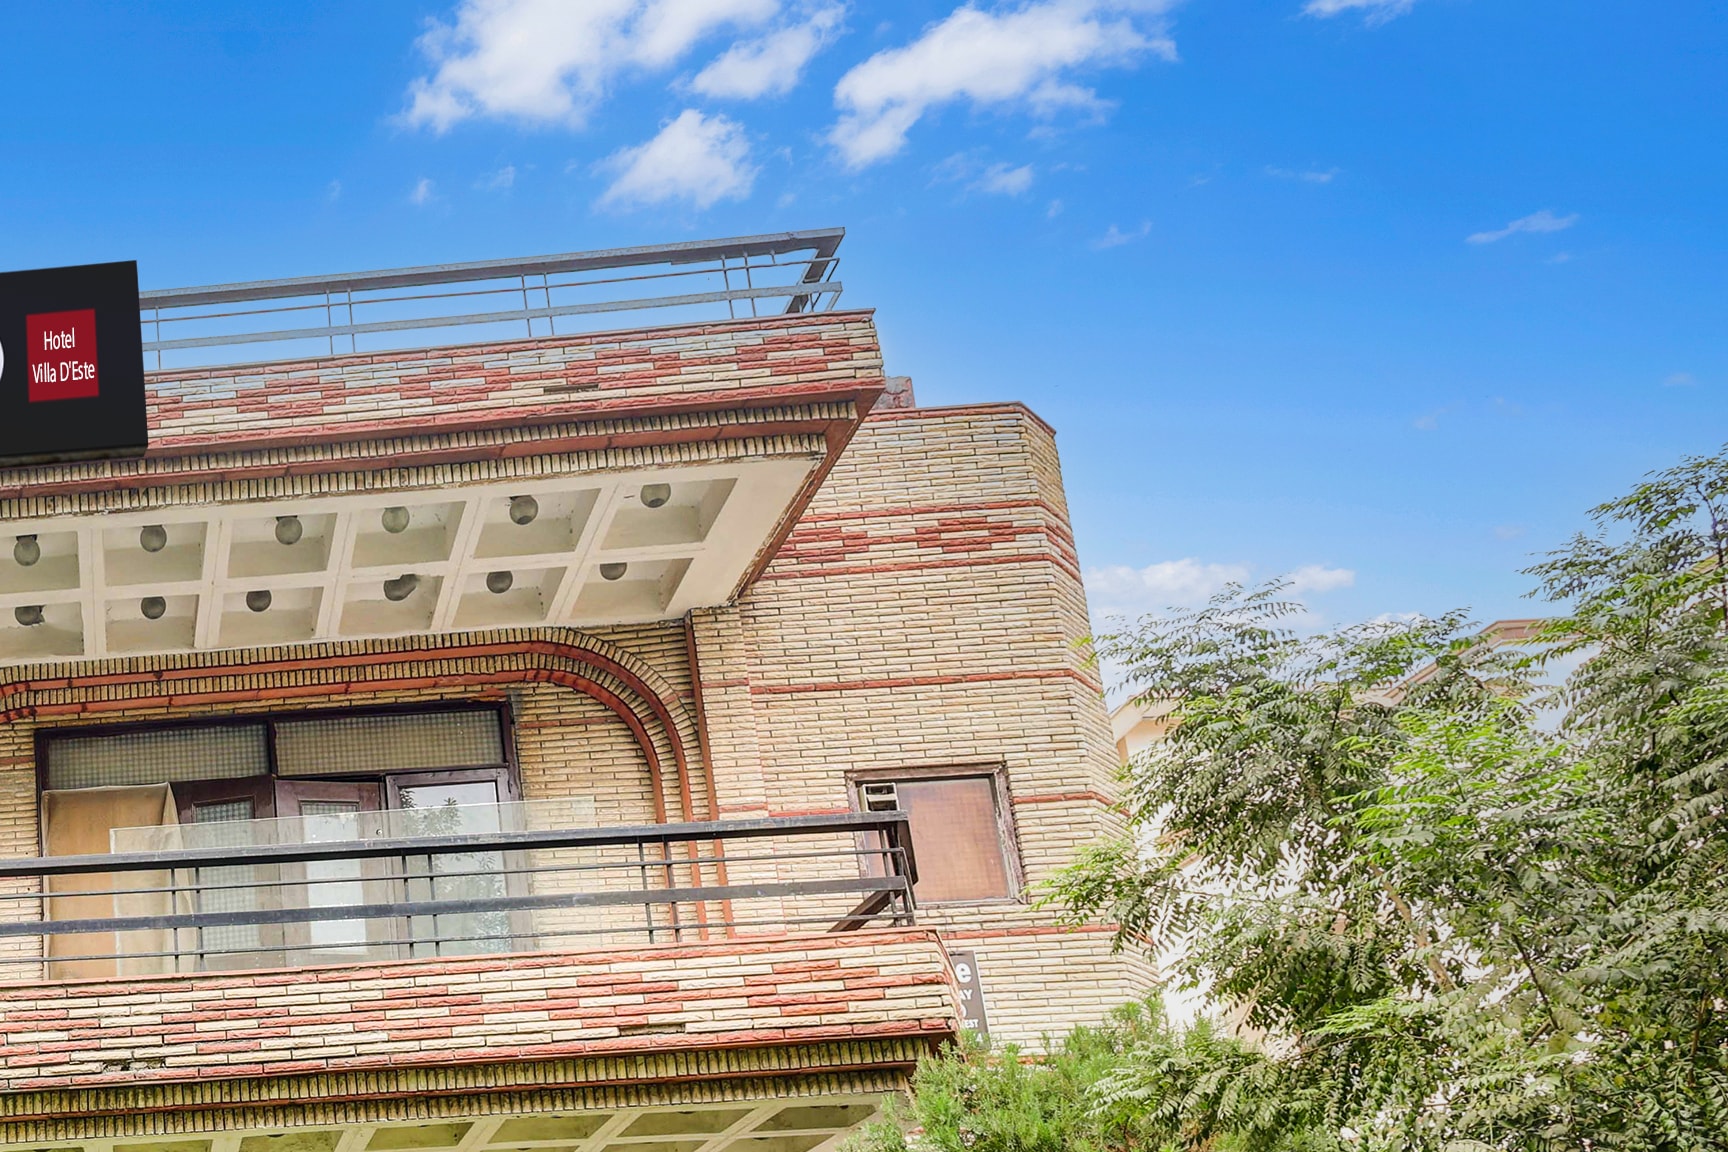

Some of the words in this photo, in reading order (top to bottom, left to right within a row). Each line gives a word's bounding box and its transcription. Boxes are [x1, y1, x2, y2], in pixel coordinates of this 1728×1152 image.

[44, 327, 76, 351] Hotel
[32, 361, 57, 384] Villa
[60, 360, 95, 382] D'Este
